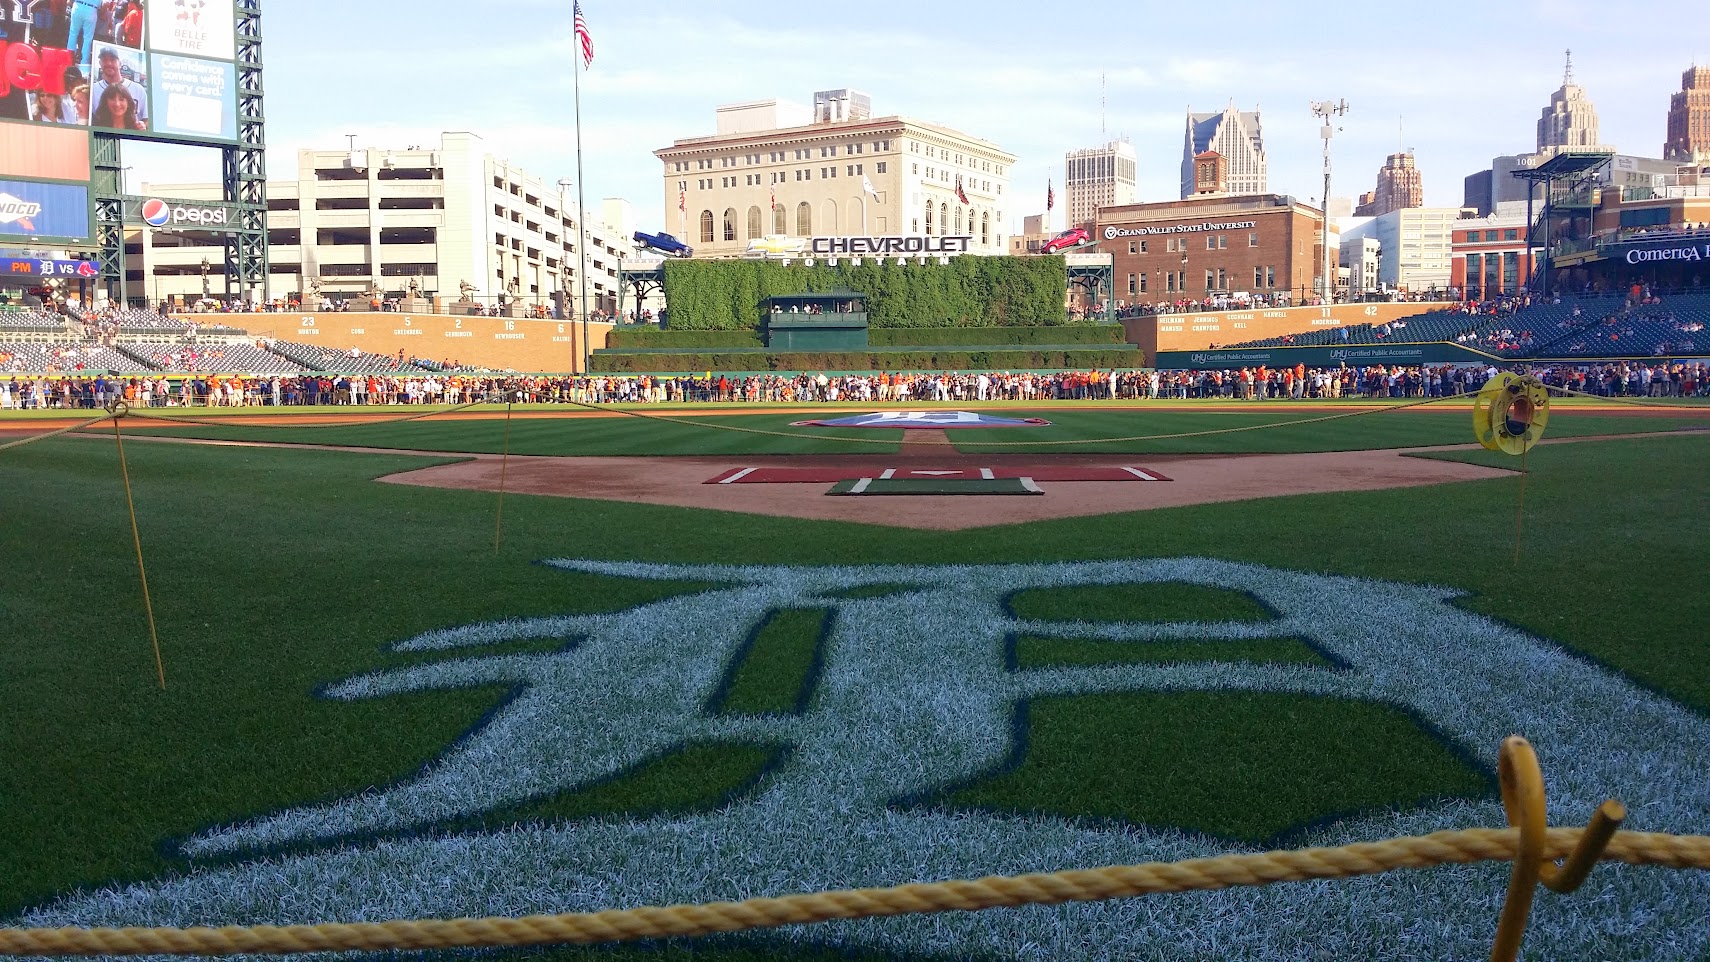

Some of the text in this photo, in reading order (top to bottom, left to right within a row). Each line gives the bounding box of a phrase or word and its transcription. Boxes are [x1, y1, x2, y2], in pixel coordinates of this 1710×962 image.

[174, 28, 207, 40] BELLE
[179, 39, 202, 50] TIRE
[161, 57, 224, 75] Confidence
[161, 71, 224, 87] comes with
[161, 82, 193, 96] every
[1516, 158, 1537, 166] 1001
[173, 207, 227, 226] pepsi
[1117, 220, 1256, 237] GRAND VALLEY STATE UNIVERSITY
[811, 236, 973, 253] CHEVROLET
[11, 262, 31, 273] PM
[782, 257, 950, 267] FOUNTAIN
[1321, 307, 1331, 318] 11
[1364, 306, 1378, 316] 42
[301, 316, 315, 327] 23
[404, 316, 411, 326] 5
[1227, 313, 1255, 321] COCHRANE
[455, 319, 462, 329] 2
[504, 320, 515, 331] 16
[558, 323, 564, 333] 6
[1388, 348, 1423, 356] Accountants
